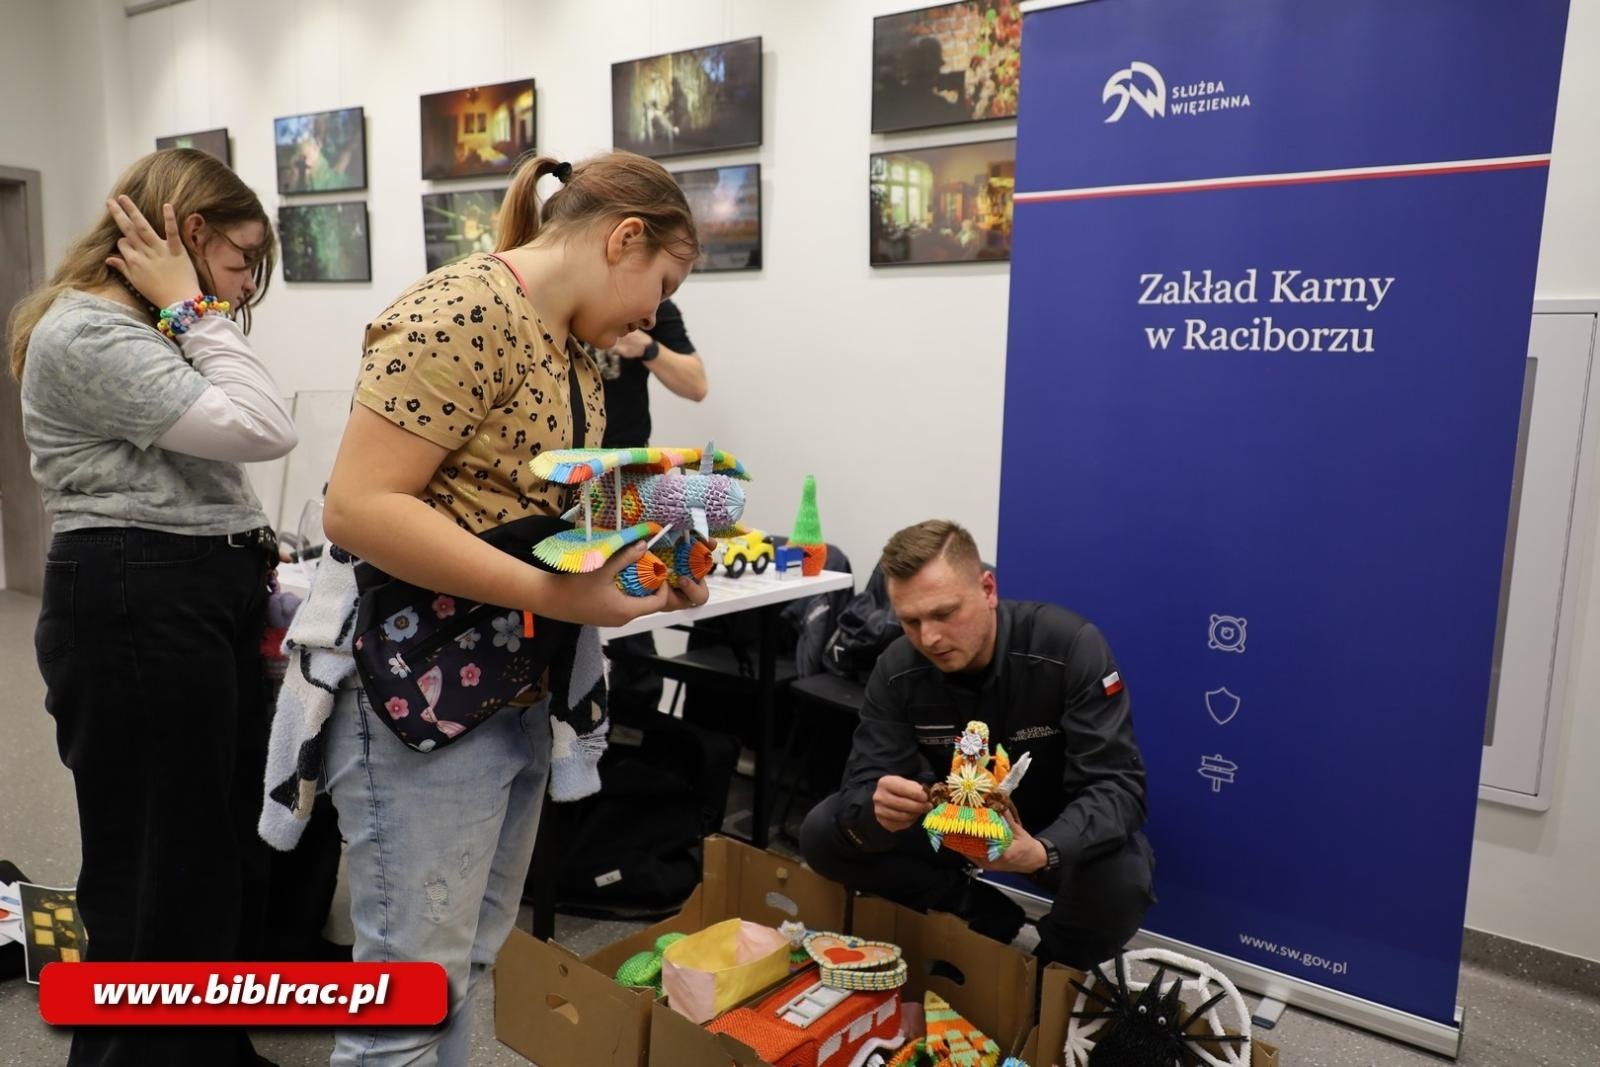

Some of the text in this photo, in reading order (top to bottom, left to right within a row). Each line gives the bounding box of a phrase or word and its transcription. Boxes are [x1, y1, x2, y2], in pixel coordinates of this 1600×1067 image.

[1171, 80, 1225, 99] SŁUŻBA
[1171, 94, 1251, 116] WIĘZIENNA
[1138, 268, 1395, 312] Zakład Karny
[1145, 317, 1375, 353] w Raciborzu
[1239, 933, 1348, 975] www.sw.gov.pl
